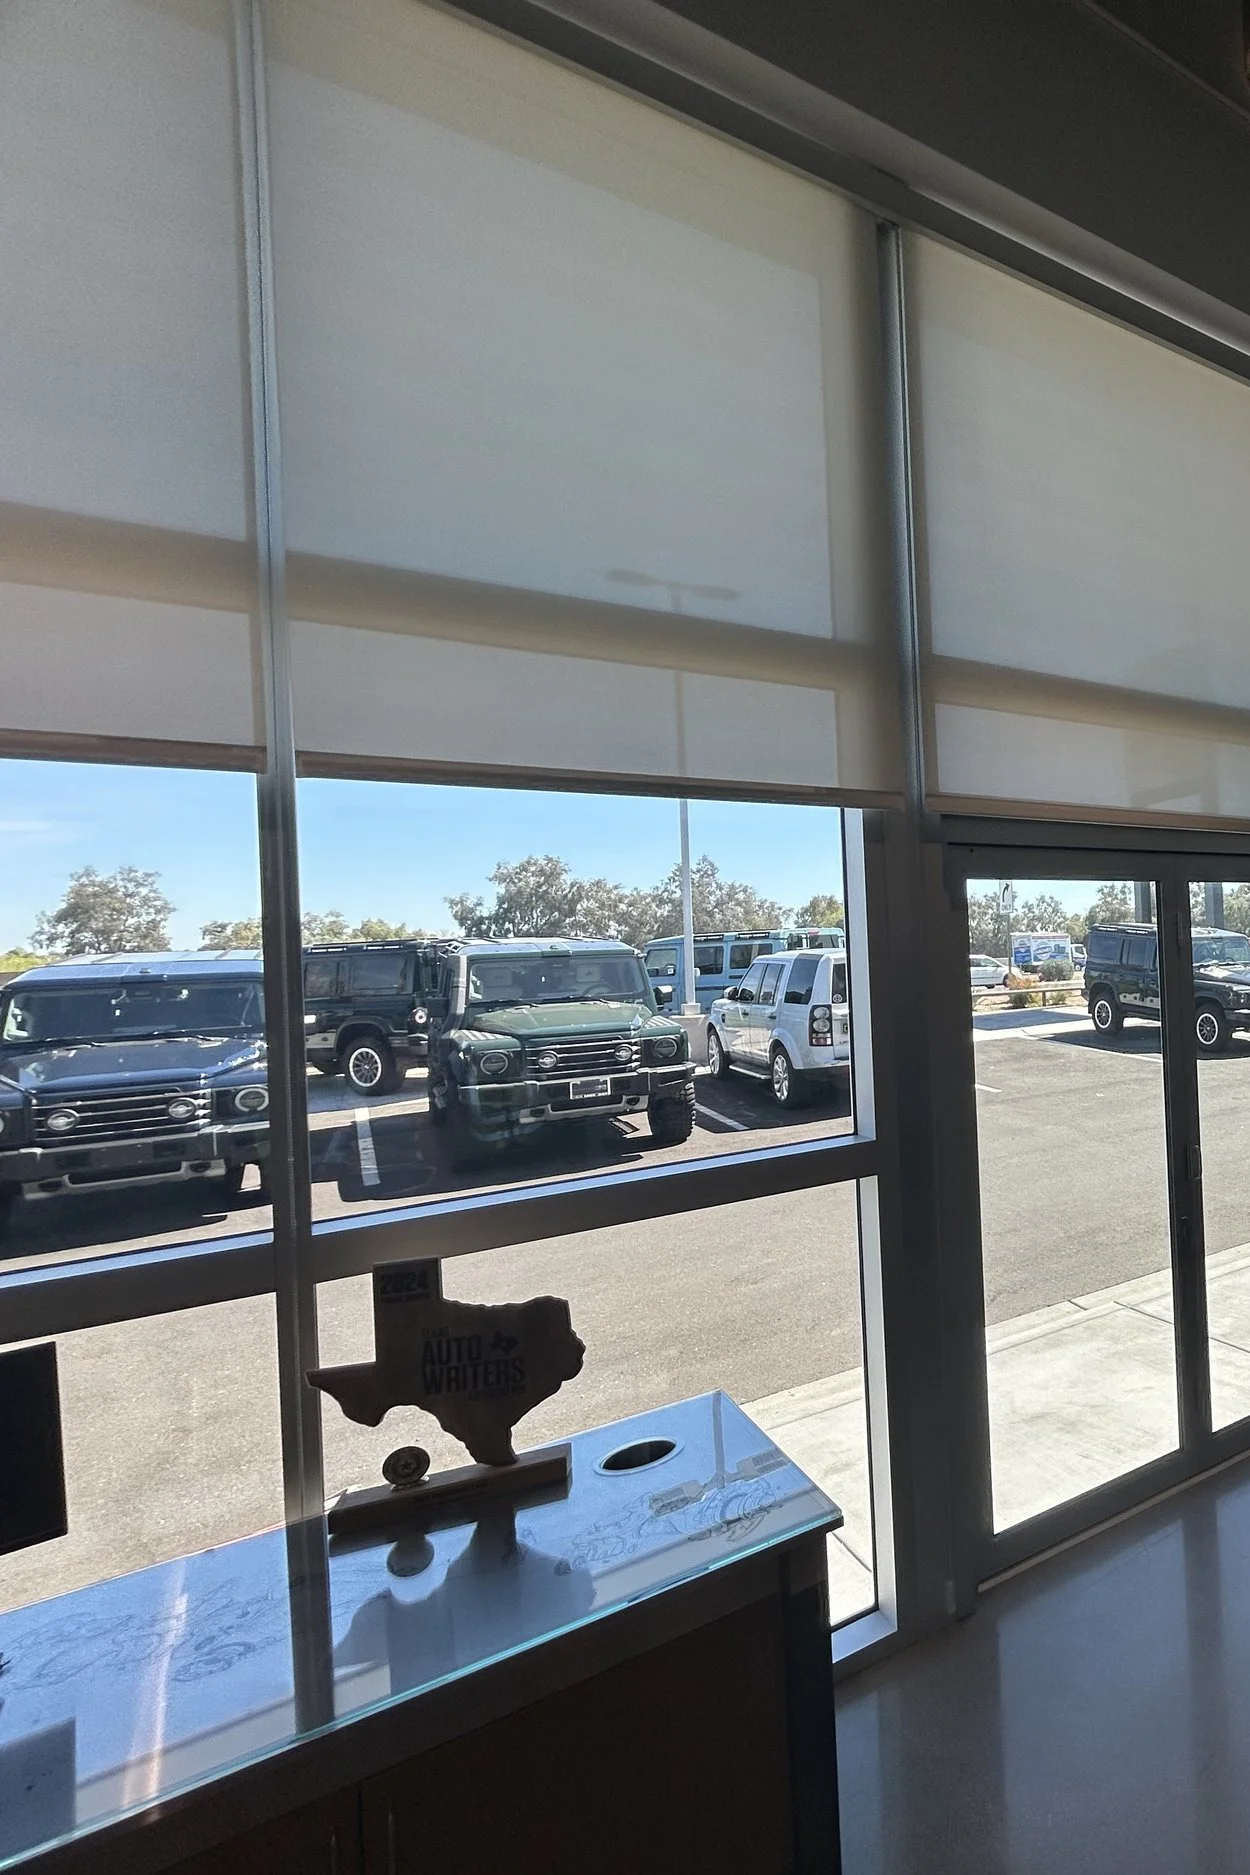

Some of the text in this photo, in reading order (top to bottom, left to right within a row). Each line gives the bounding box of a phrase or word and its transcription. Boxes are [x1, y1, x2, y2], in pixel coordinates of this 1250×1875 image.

[380, 1270, 430, 1294] 2024
[422, 1335, 482, 1366] AUTO
[421, 1356, 526, 1396] WRITERS
